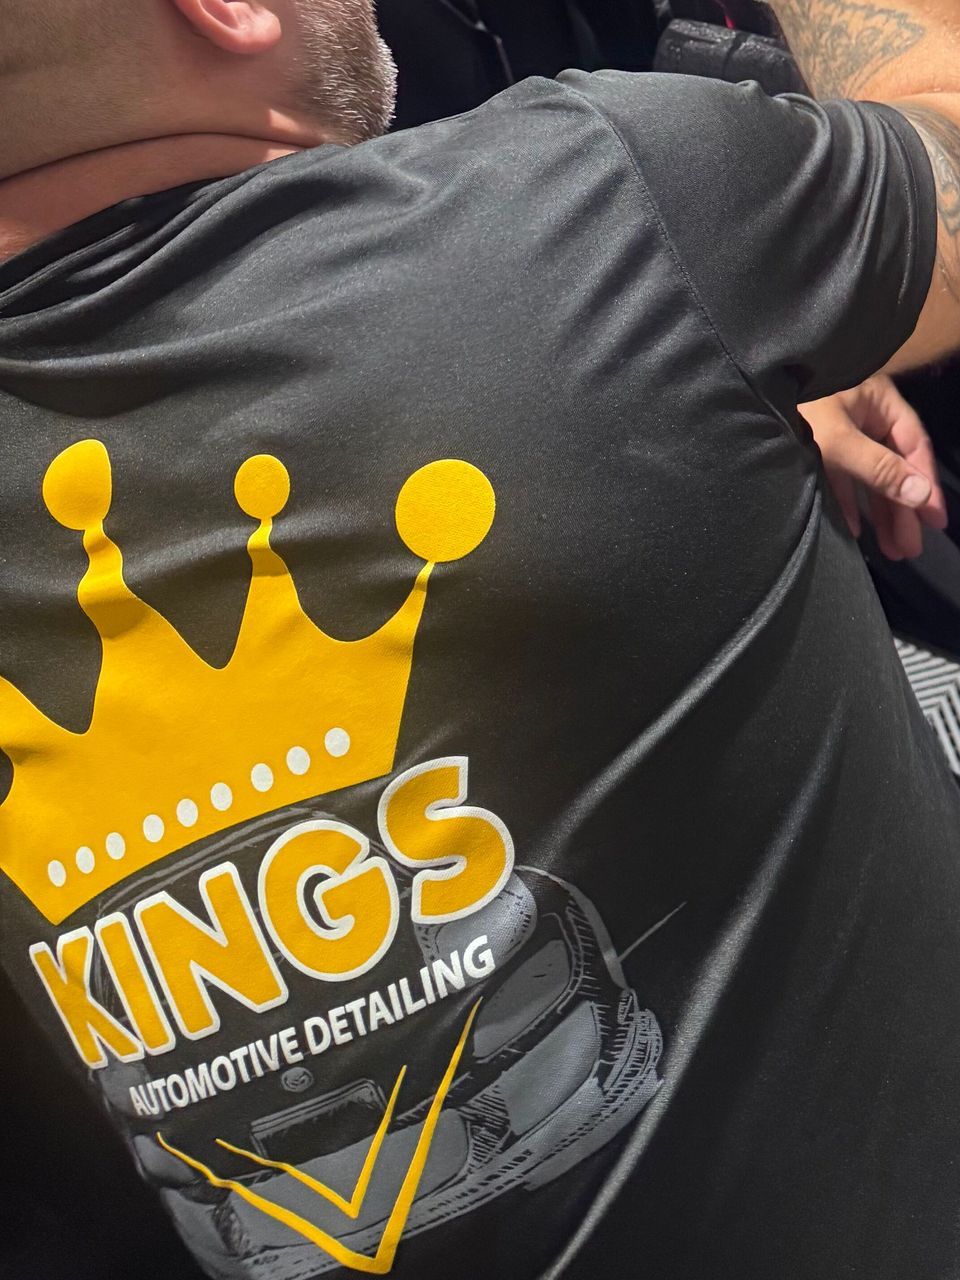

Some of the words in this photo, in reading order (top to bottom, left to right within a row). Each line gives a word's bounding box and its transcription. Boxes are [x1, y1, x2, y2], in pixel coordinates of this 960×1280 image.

[29, 756, 516, 1070] KINGS
[129, 1029, 304, 1117] AUTOMOTIVE
[305, 934, 497, 1052] DETAILING
